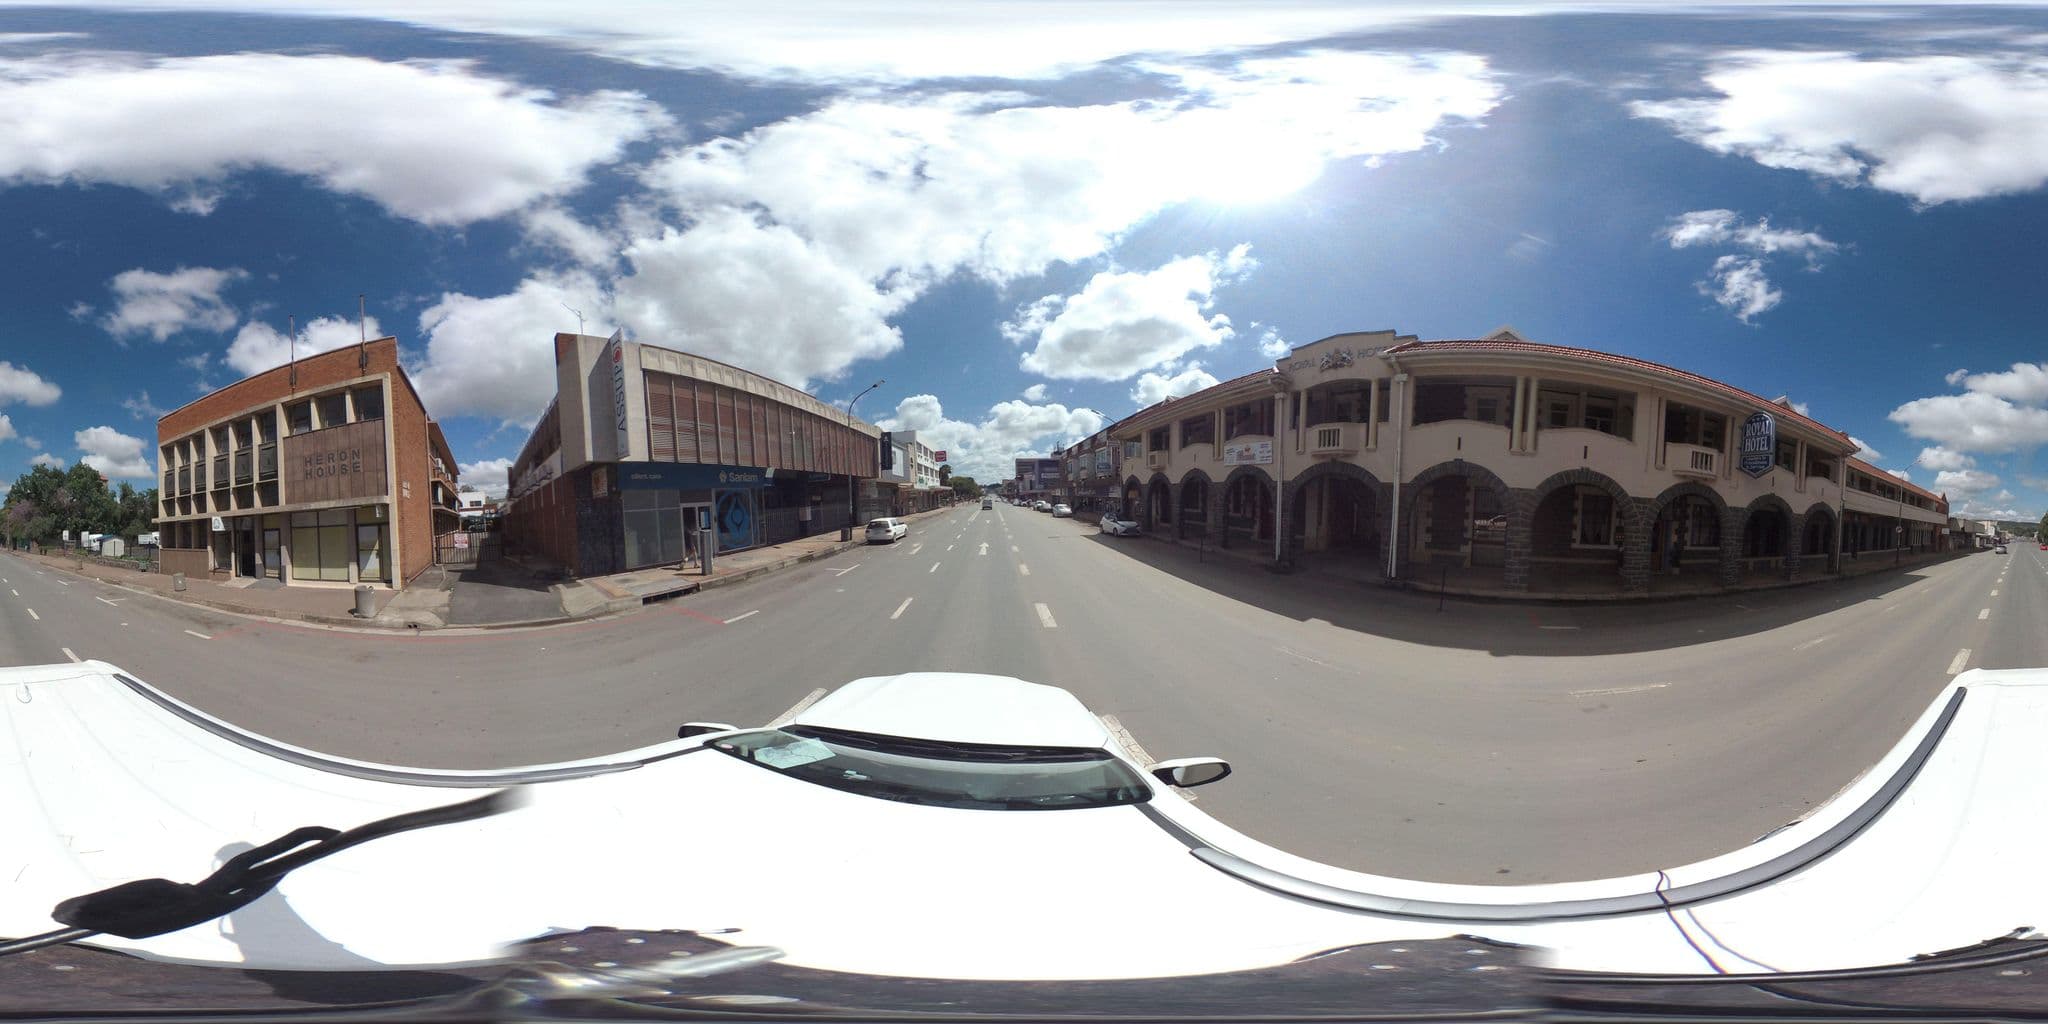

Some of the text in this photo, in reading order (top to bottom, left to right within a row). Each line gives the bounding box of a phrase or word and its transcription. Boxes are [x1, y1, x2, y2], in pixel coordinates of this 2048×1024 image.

[1745, 420, 1770, 437] ROYAL
[1744, 436, 1769, 452] HOTEL
[304, 448, 361, 467] HERON
[305, 462, 361, 480] HOUSE
[728, 471, 758, 483] Sanlam
